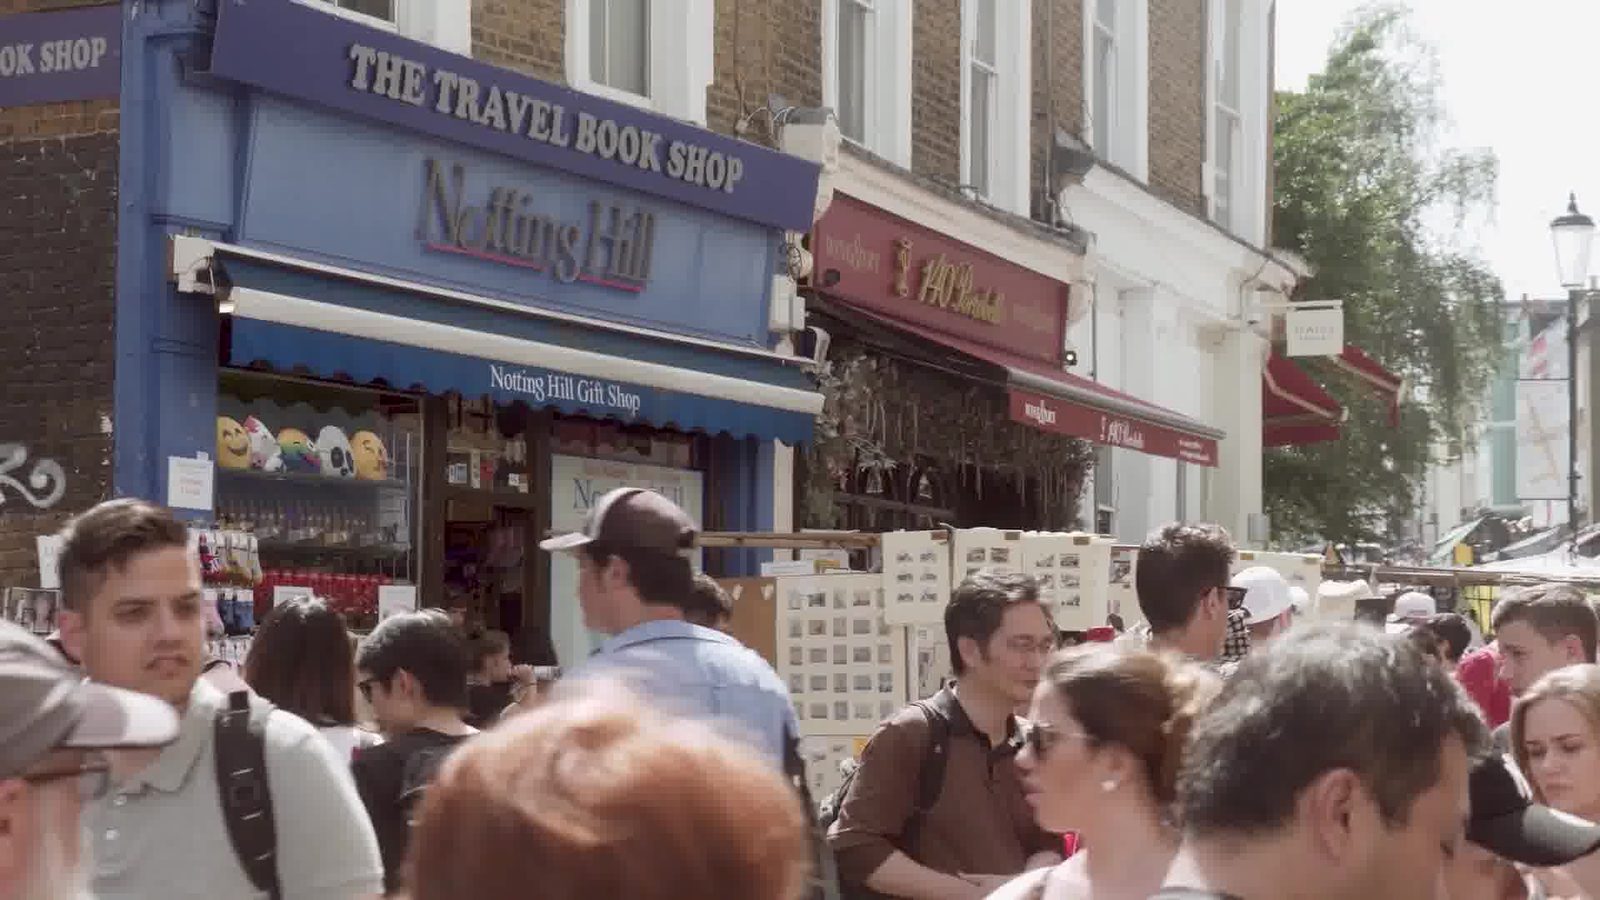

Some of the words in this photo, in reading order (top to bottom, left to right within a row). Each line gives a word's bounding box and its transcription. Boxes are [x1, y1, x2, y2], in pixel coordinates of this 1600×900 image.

[40, 37, 107, 73] SHOP
[350, 43, 426, 106] THE
[434, 69, 568, 147] TRAVEL
[575, 111, 662, 172] BOOK
[667, 140, 744, 194] SHOP
[414, 157, 582, 283] Notting
[585, 200, 655, 281] Hill
[489, 364, 545, 401] Notting
[547, 373, 574, 400] Hill
[577, 379, 605, 405] Gift
[608, 384, 641, 417] Shop
